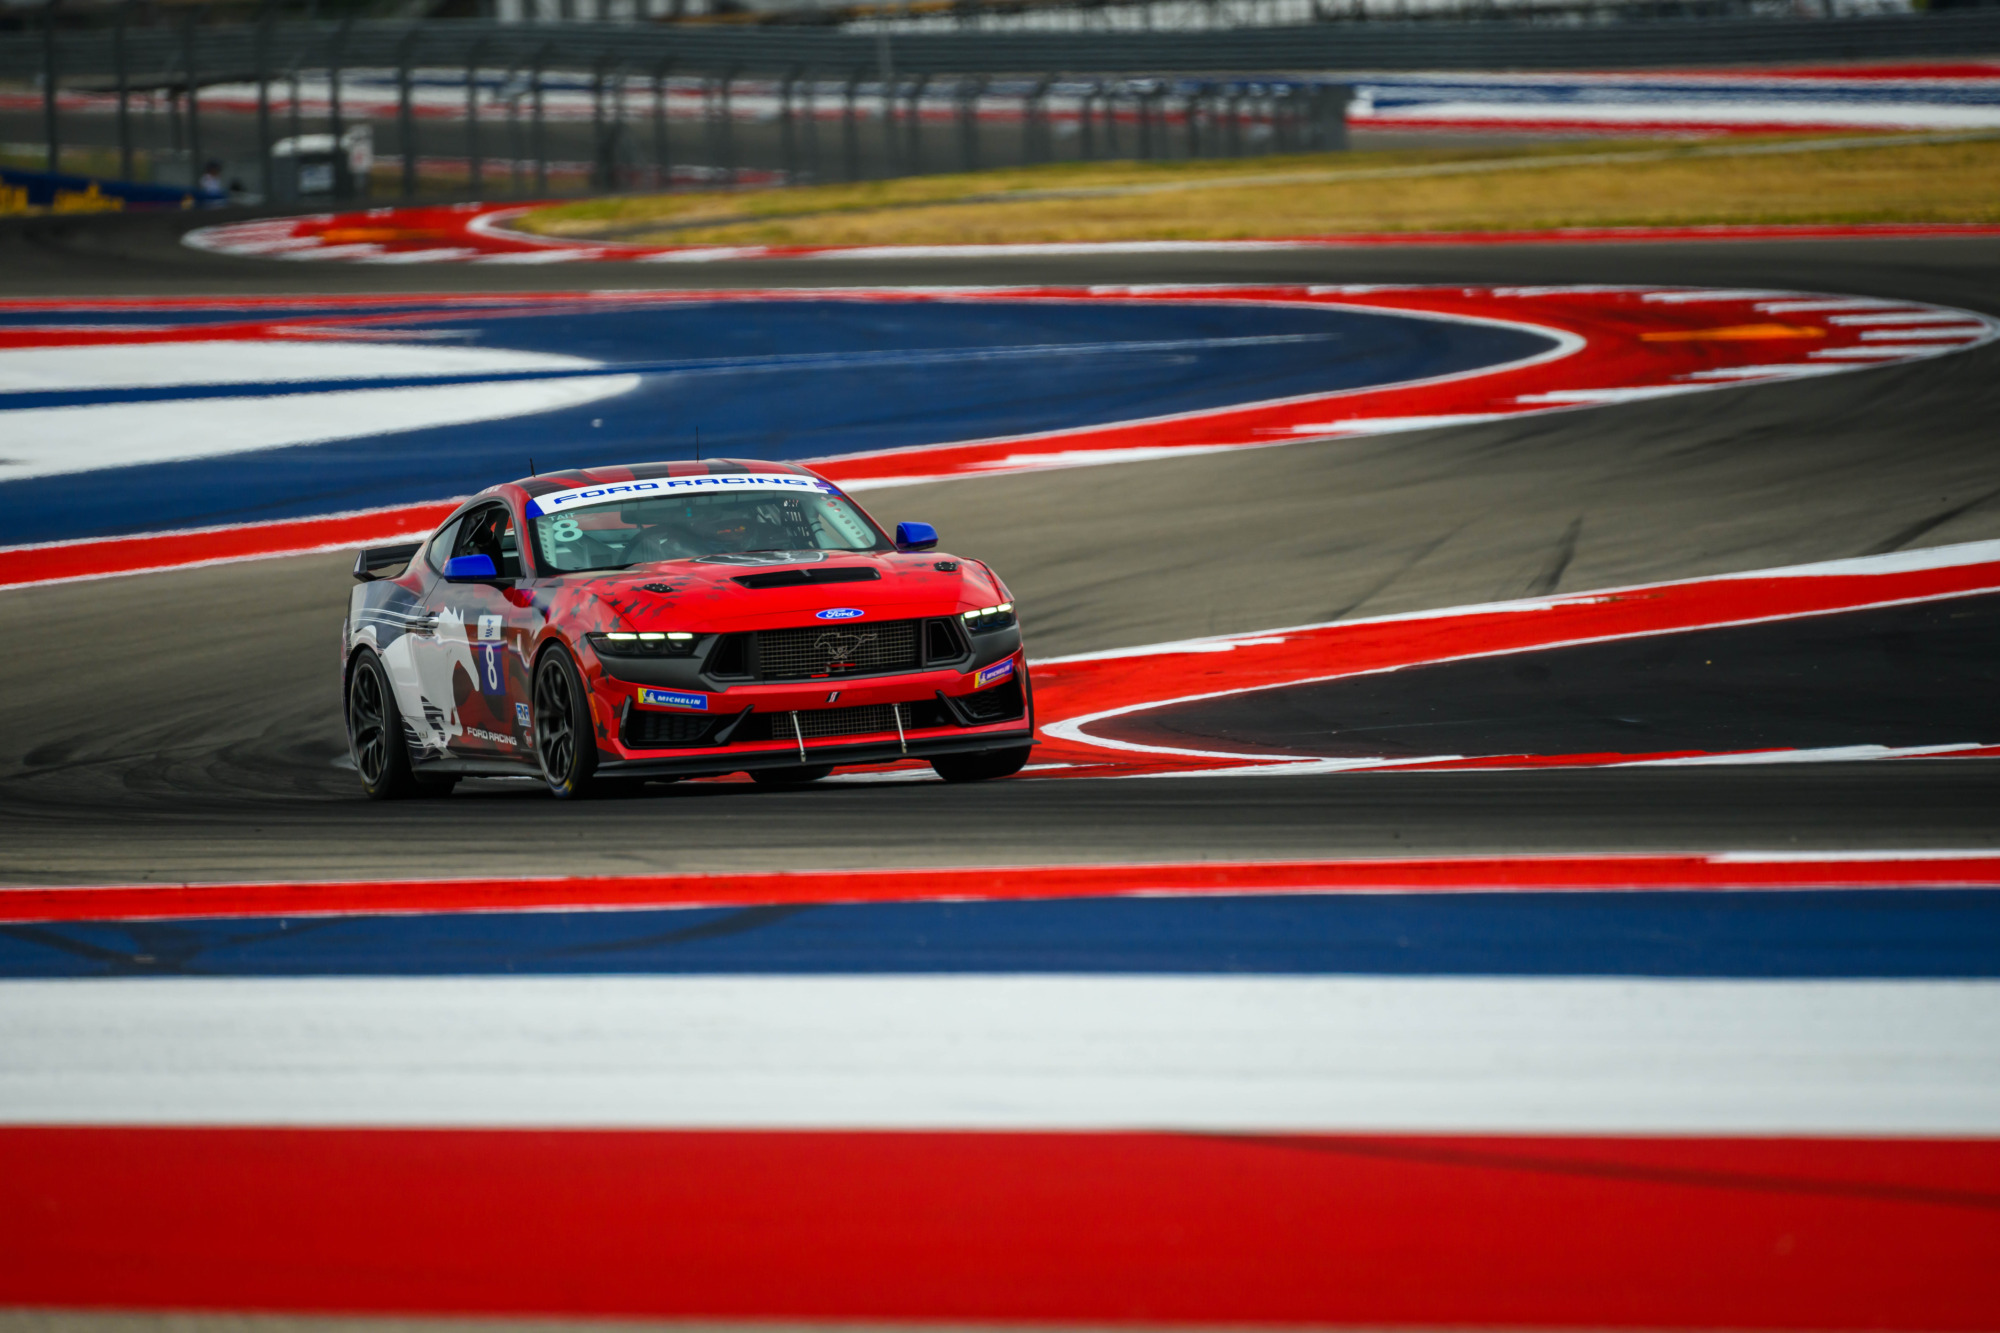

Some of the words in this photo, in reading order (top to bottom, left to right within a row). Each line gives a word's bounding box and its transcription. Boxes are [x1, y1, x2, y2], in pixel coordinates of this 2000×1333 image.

[554, 483, 659, 504] FORD
[667, 478, 808, 487] RACING
[548, 512, 575, 521] TAIT
[552, 519, 583, 542] 8
[826, 609, 854, 618] Ford
[485, 644, 498, 690] 8
[657, 695, 701, 705] MICHELIN
[467, 726, 489, 740] FORD
[488, 731, 517, 746] RACING
